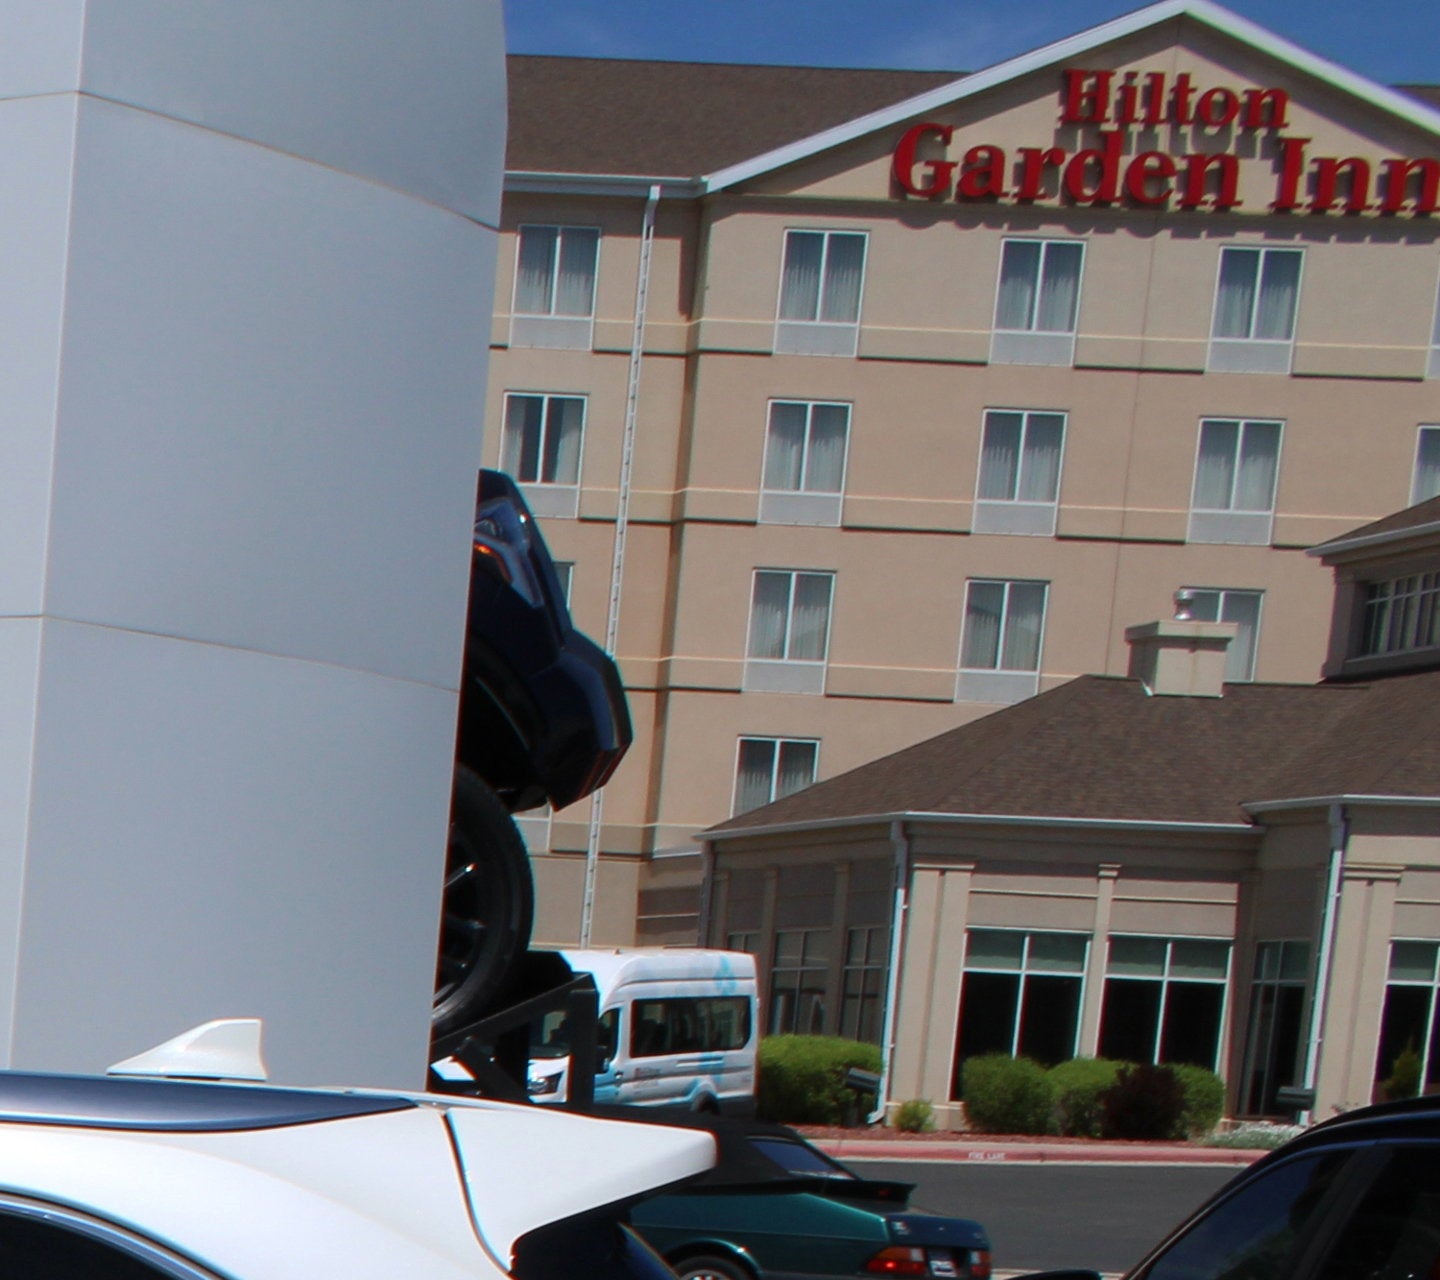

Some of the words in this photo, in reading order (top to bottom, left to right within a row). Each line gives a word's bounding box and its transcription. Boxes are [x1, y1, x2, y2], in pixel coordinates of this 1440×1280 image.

[1058, 68, 1291, 129] Hilton
[892, 122, 1243, 208] Garden
[1270, 136, 1440, 213] Inn
